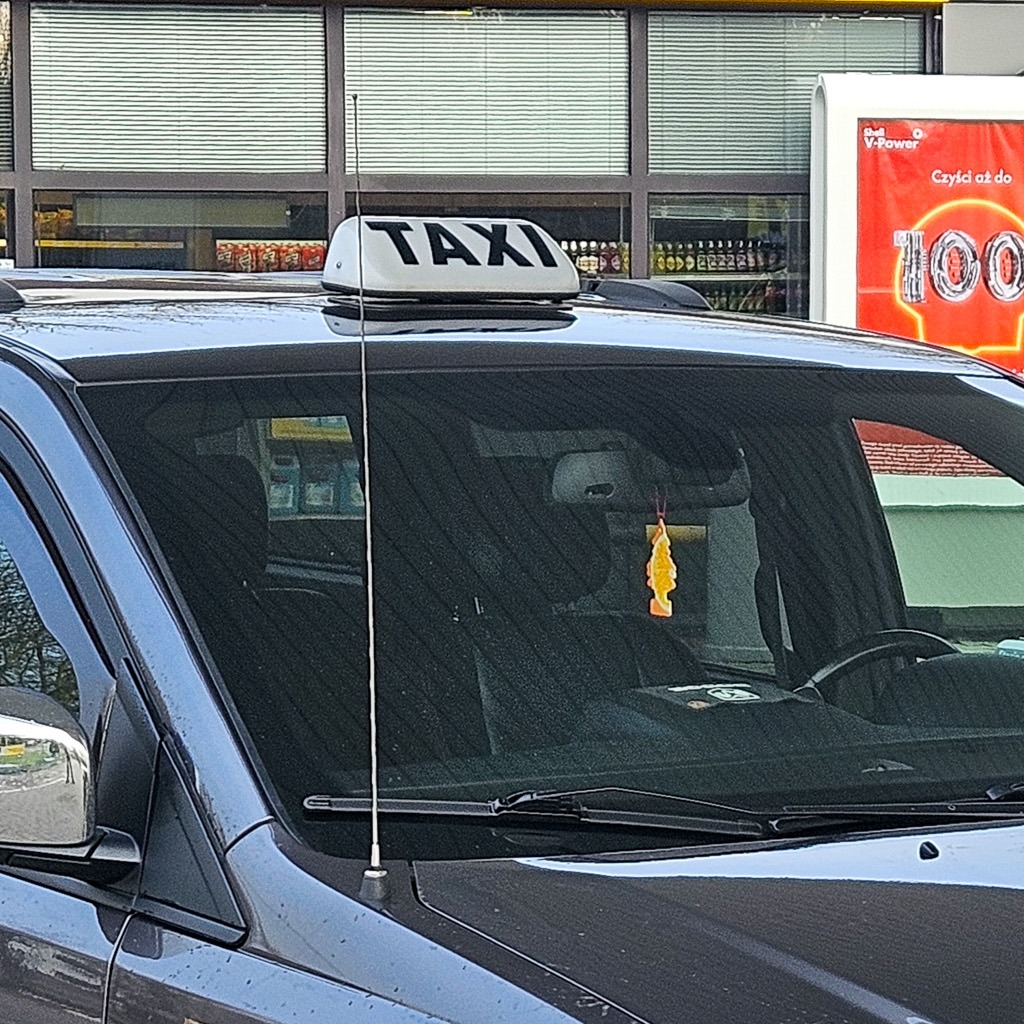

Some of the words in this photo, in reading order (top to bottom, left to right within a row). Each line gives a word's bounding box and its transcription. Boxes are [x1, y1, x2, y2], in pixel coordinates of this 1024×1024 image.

[863, 128, 885, 137] Shell
[863, 137, 919, 149] V-Power
[931, 169, 972, 187] Czyści
[975, 171, 992, 184] aż
[994, 169, 1012, 184] do
[365, 221, 558, 267] TAXI
